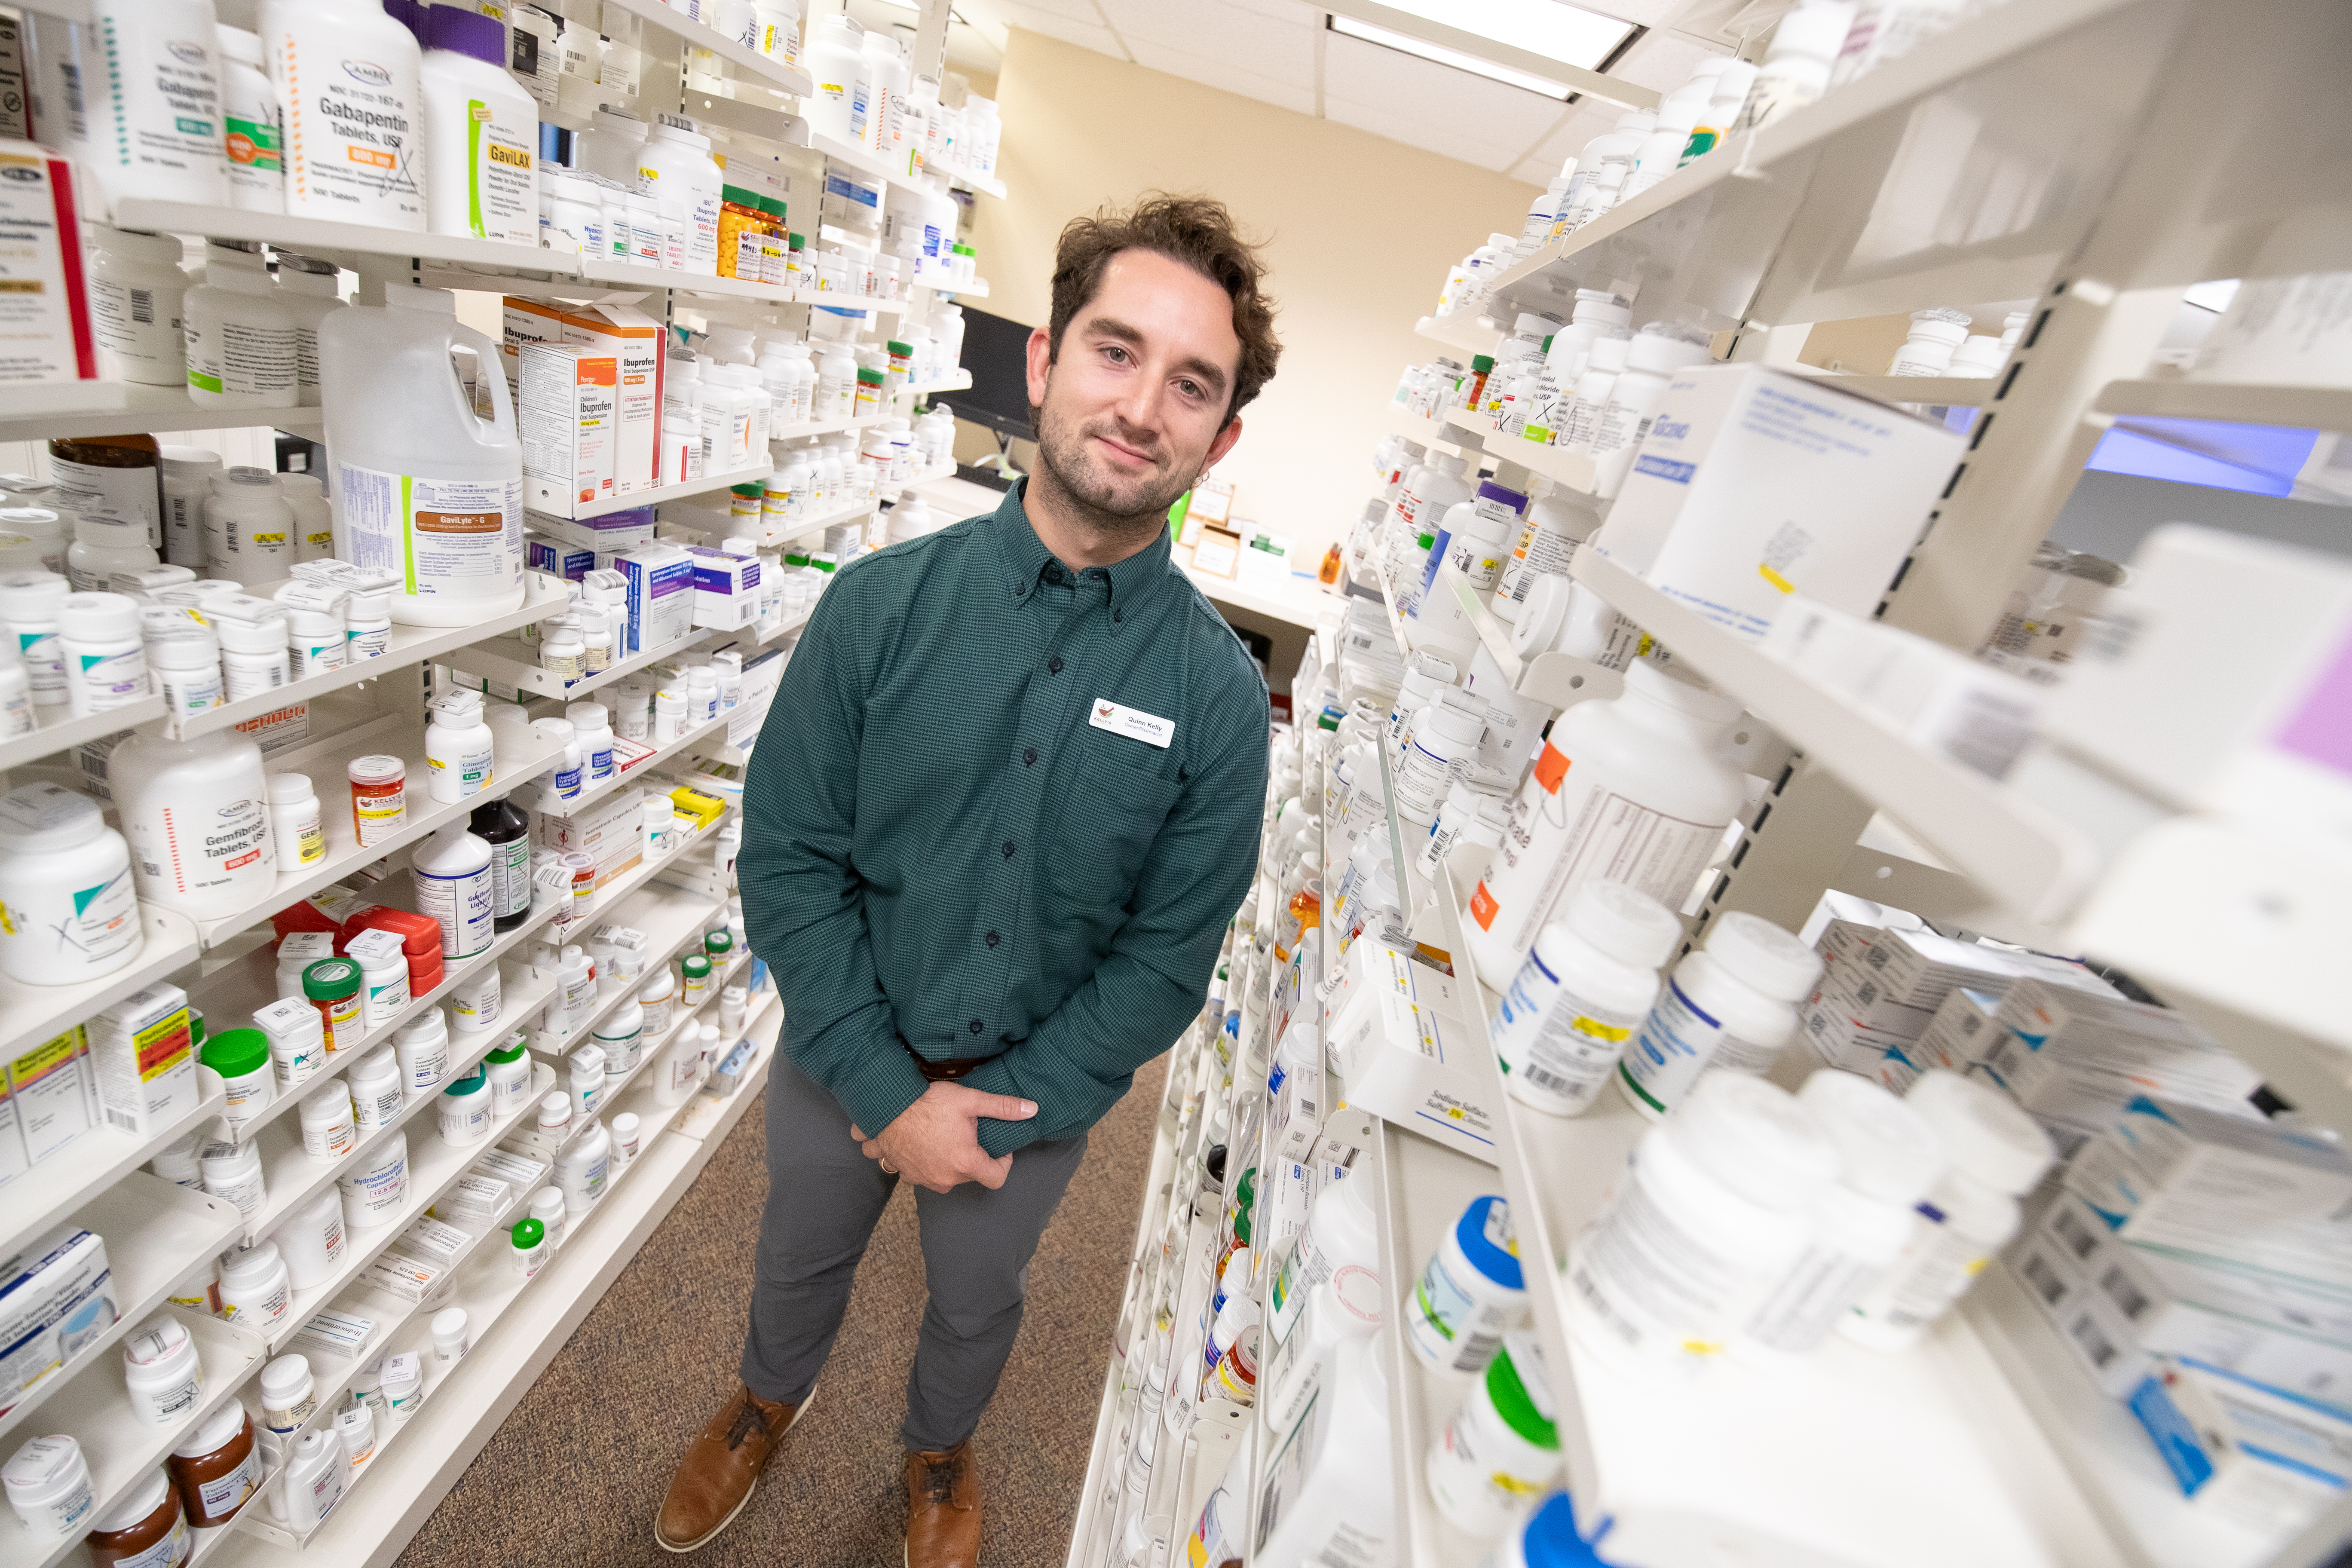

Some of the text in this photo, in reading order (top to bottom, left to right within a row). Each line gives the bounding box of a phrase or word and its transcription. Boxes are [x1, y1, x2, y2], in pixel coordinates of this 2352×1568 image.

[320, 97, 408, 132] Gabapentin
[331, 121, 403, 148] Tablets, USP
[491, 146, 530, 169] GaviLAX
[693, 214, 711, 225] Tablets,
[624, 358, 655, 368] Ibuprofen
[580, 401, 611, 414] Ibuprofen
[1124, 722, 1162, 738] Owner/Pharmacist
[1128, 717, 1162, 732] Quinn Kelly
[462, 764, 486, 773] Tablets,
[374, 794, 401, 803] KELLY'S
[585, 801, 642, 836] Isotretinoin Capsules, USP
[205, 839, 251, 858] Tablets,
[228, 852, 259, 868] 600 mg
[415, 1056, 438, 1064] Guanfacine
[1432, 1089, 1461, 1106] Sodium
[1426, 1098, 1450, 1114] Sulfur
[366, 1166, 404, 1189] Capsules, USP
[374, 1182, 398, 1196] 12.5 mg
[459, 1184, 496, 1197] Hydrocortisone
[441, 1233, 461, 1246] Ointment
[374, 1264, 424, 1286] Hydrocortisone Valerate
[317, 1320, 362, 1336] Hydrocortisone
[218, 1492, 230, 1501] mg
